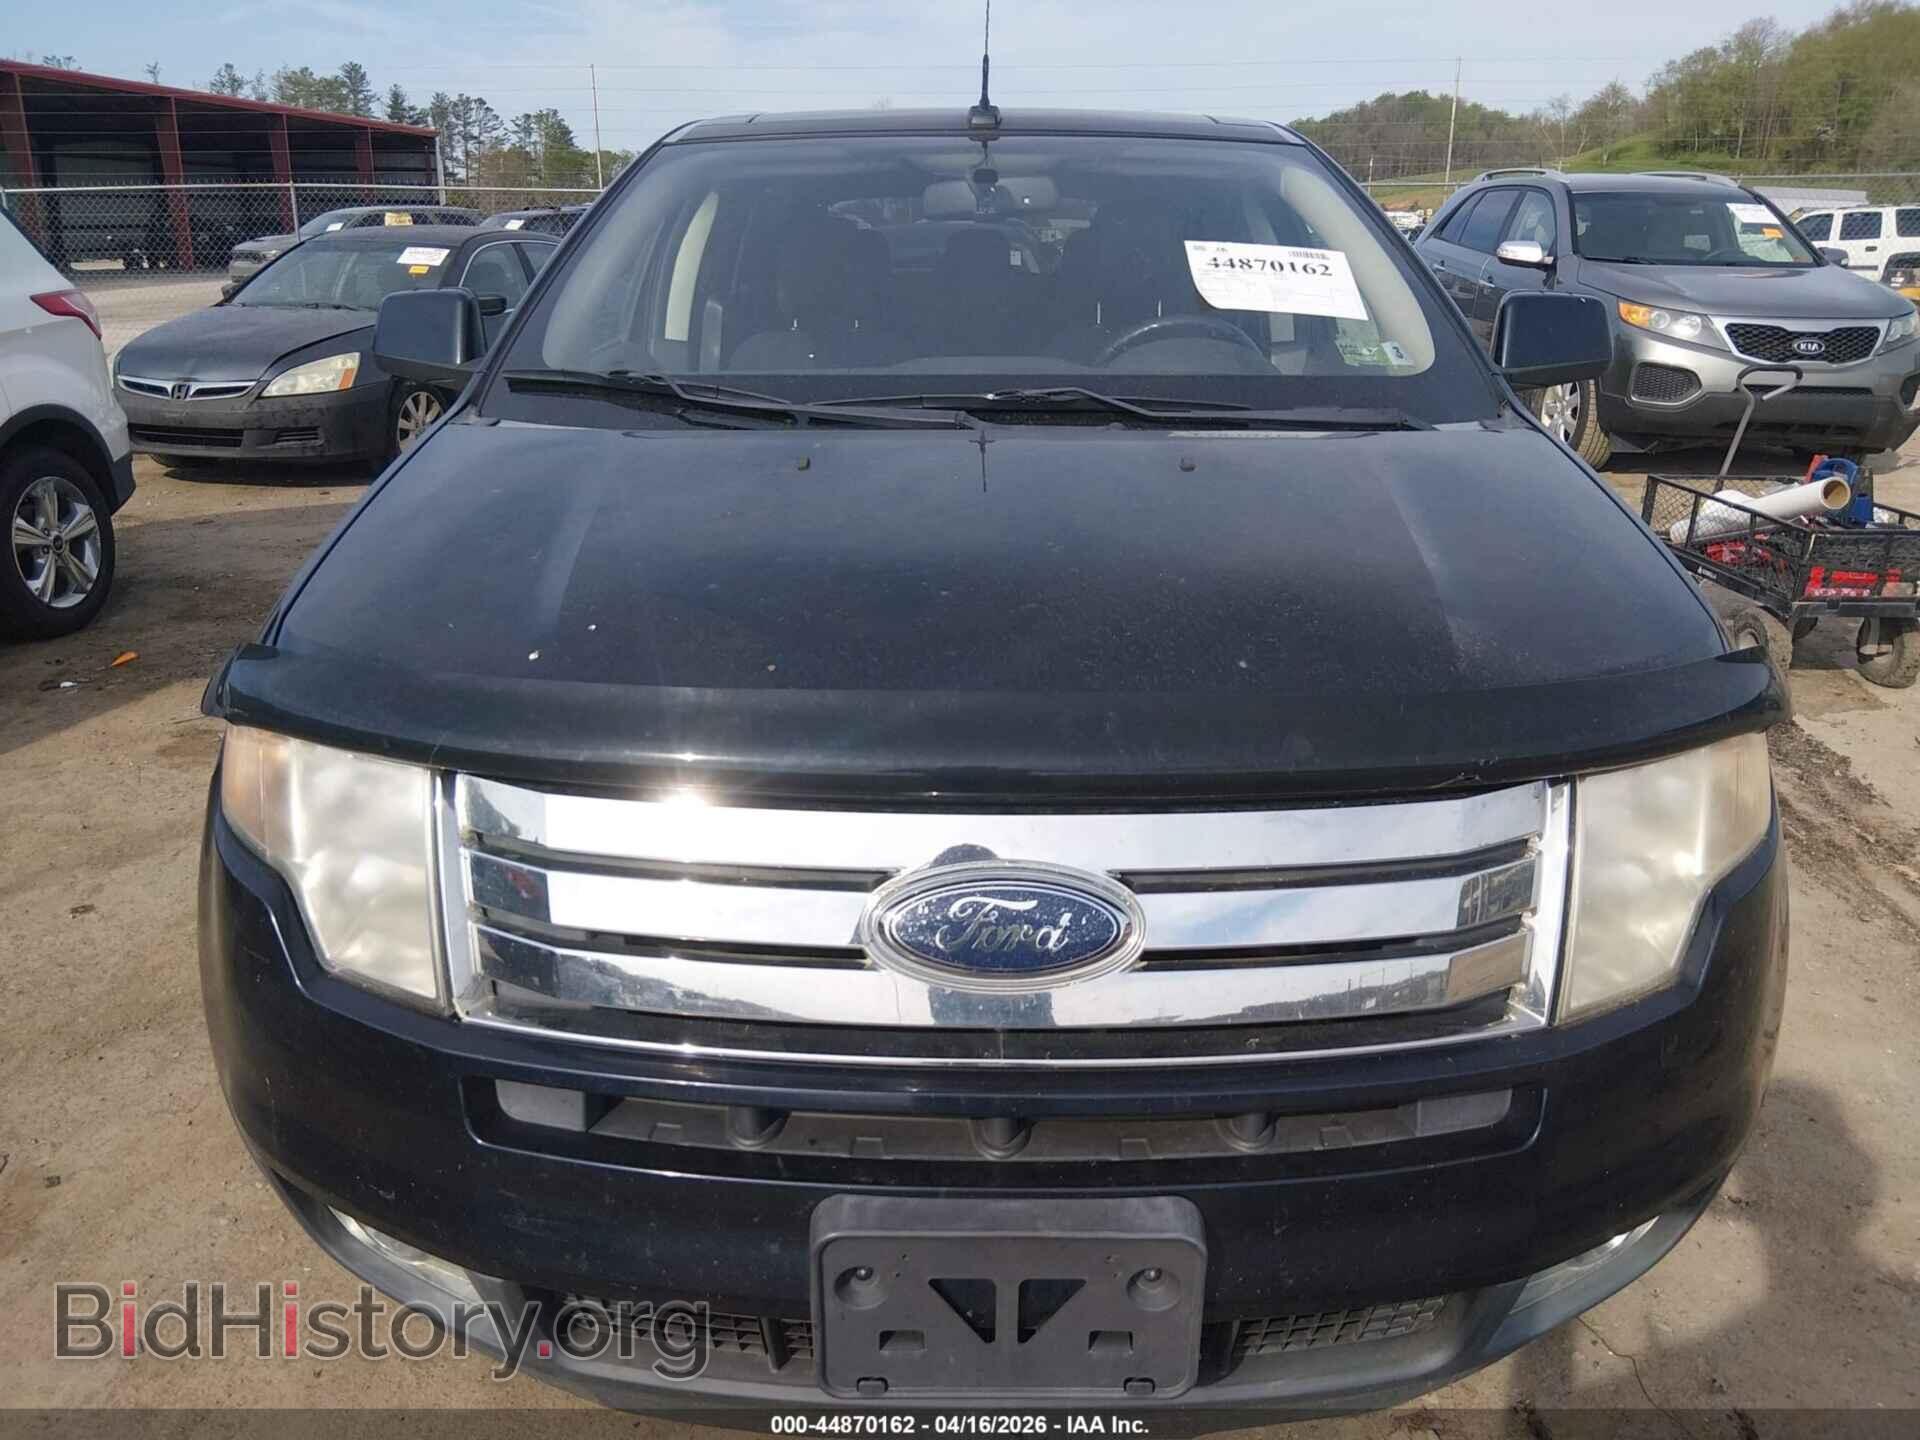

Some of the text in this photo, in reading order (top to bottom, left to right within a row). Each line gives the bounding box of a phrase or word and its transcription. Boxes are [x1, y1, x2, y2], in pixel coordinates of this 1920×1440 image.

[1206, 256, 1333, 277] 44870162
[1799, 342, 1819, 352] KIA
[935, 895, 1071, 953] Ford
